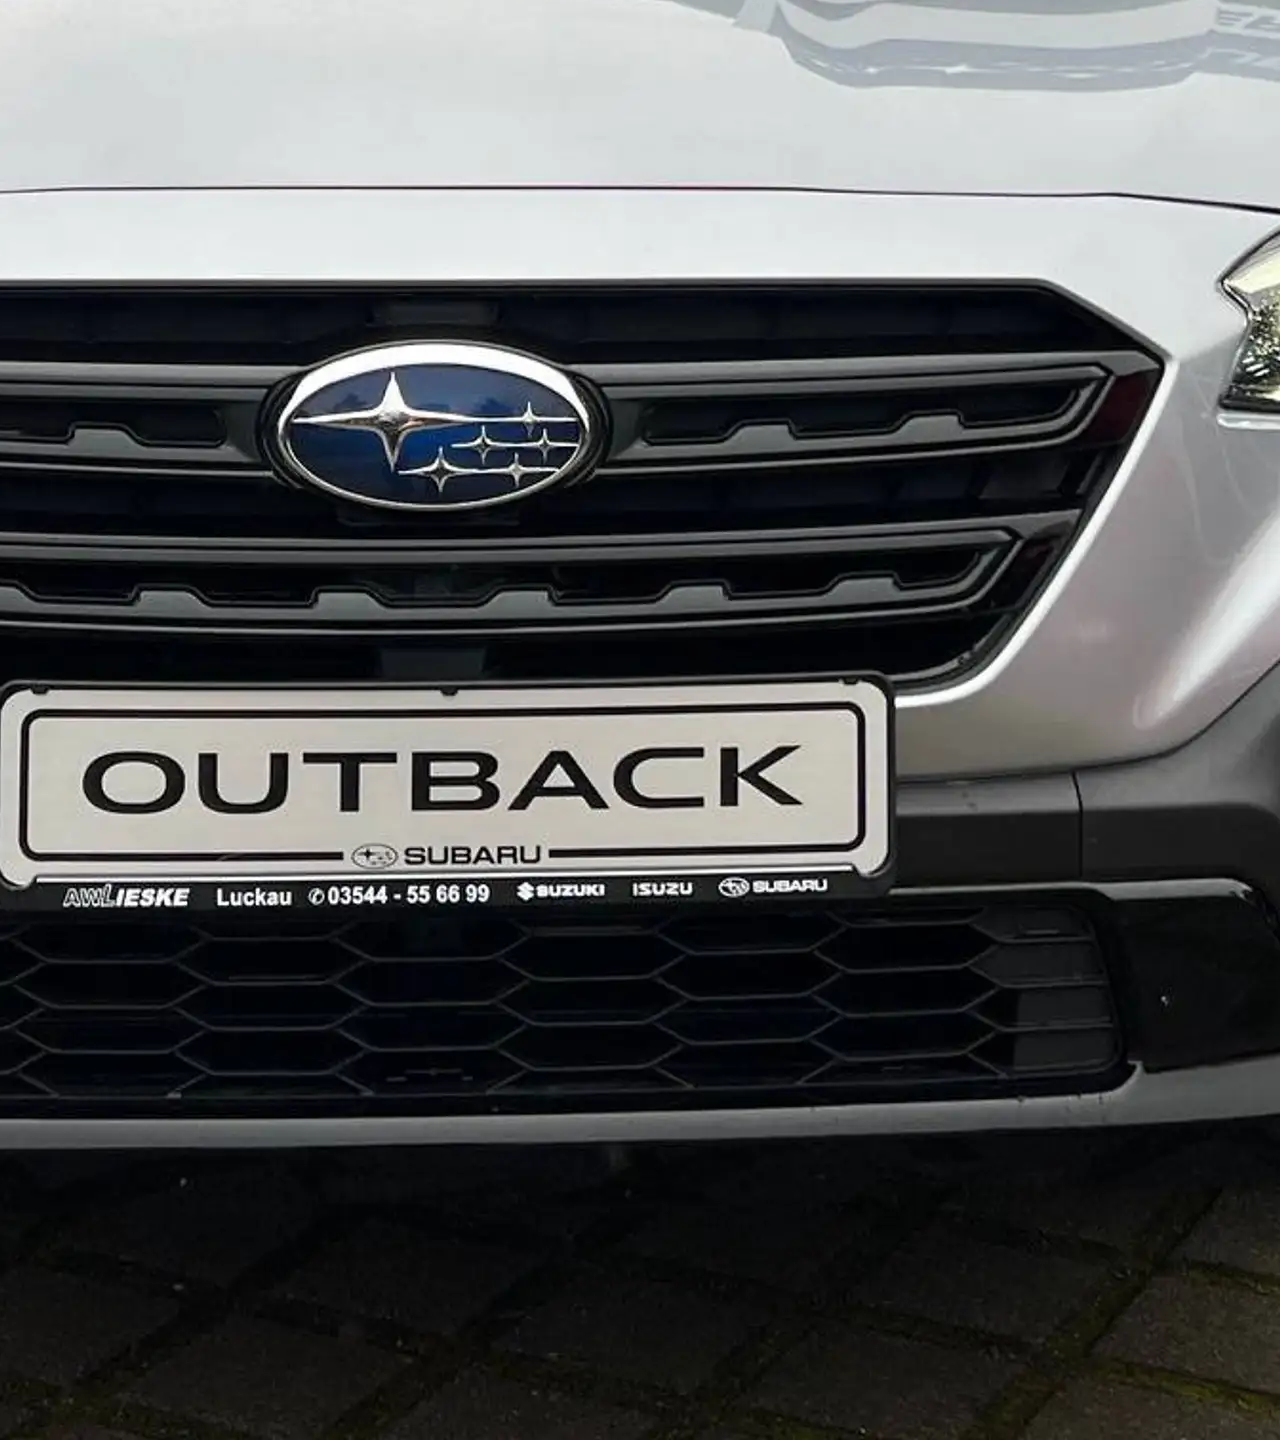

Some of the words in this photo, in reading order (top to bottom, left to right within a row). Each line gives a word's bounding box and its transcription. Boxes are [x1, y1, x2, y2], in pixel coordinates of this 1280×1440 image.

[81, 744, 803, 815] OUTBACK
[403, 844, 541, 865] SUBARU
[216, 887, 293, 907] Luckau
[327, 885, 388, 905] 03544
[406, 885, 431, 904] 55
[435, 884, 460, 903] 66
[465, 883, 490, 903] 99
[536, 883, 605, 898] SUZUKI
[632, 882, 693, 897] ISUZU
[752, 878, 828, 893] SUBARU
